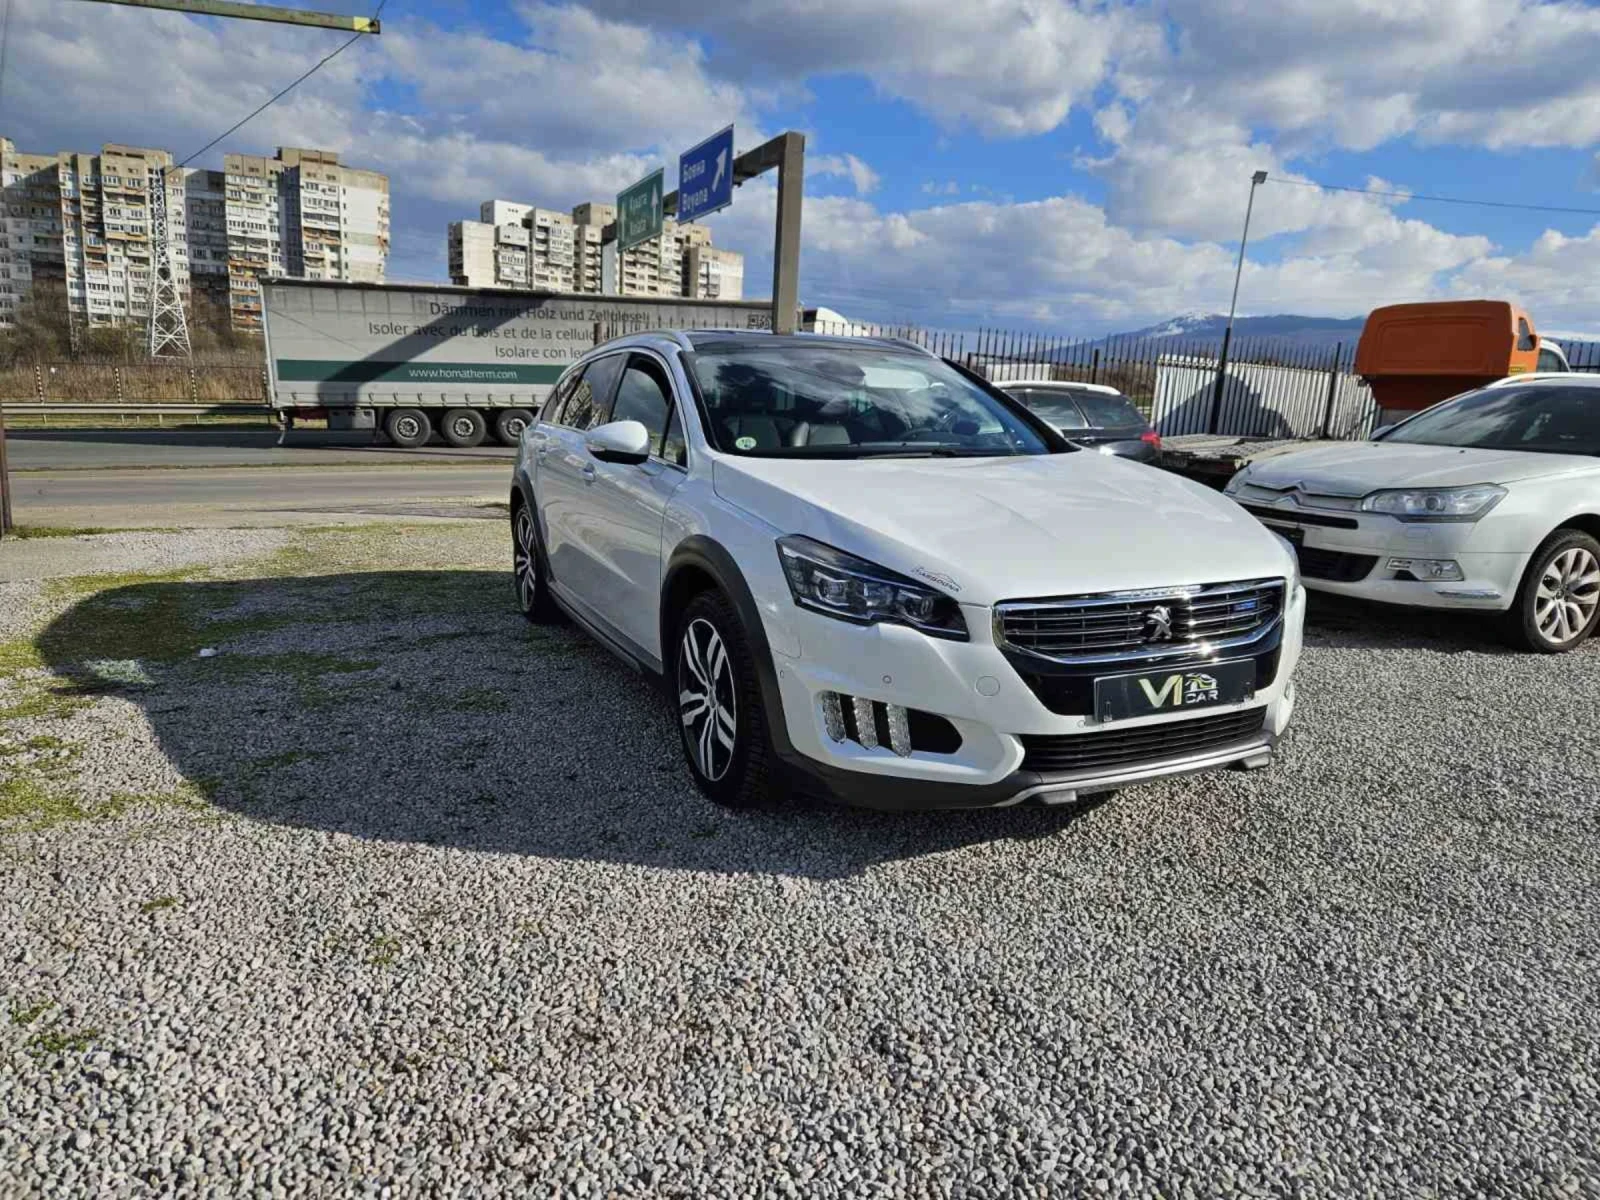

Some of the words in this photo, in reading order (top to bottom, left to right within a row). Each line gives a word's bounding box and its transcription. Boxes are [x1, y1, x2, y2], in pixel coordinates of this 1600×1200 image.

[430, 302, 495, 315] Dämmen
[527, 307, 556, 320] Holz
[560, 309, 585, 321] und
[369, 322, 408, 335] Isoler
[414, 326, 446, 336] avec
[449, 325, 467, 337] du
[472, 327, 500, 338] bois
[503, 328, 517, 339] et
[520, 327, 537, 339] de
[540, 328, 552, 340] la
[495, 345, 540, 359] Isolare
[543, 348, 567, 359] con
[408, 368, 518, 379] www.homatherm.com
[1185, 689, 1219, 704] CAR
